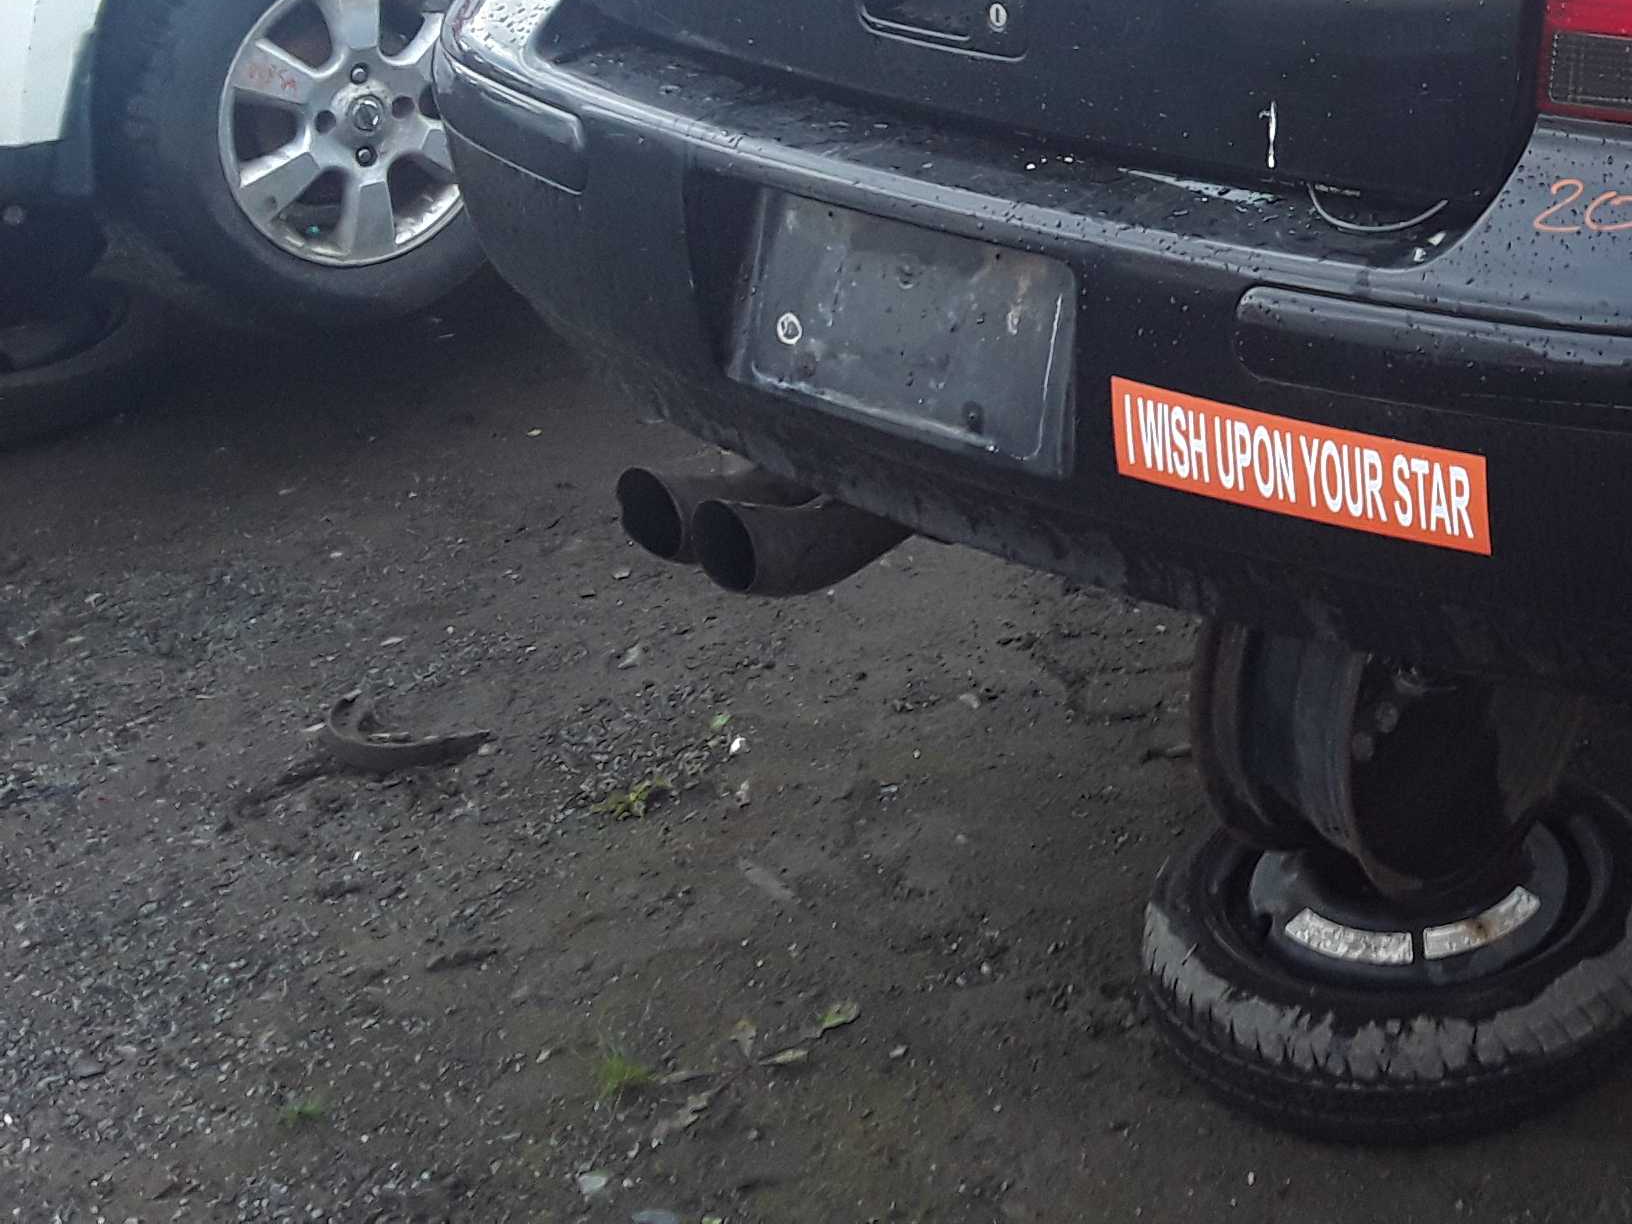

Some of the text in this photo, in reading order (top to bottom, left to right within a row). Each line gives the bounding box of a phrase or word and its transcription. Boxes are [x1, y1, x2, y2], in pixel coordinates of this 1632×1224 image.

[1124, 393, 1475, 539] I WISH UPON YOUR STAR
